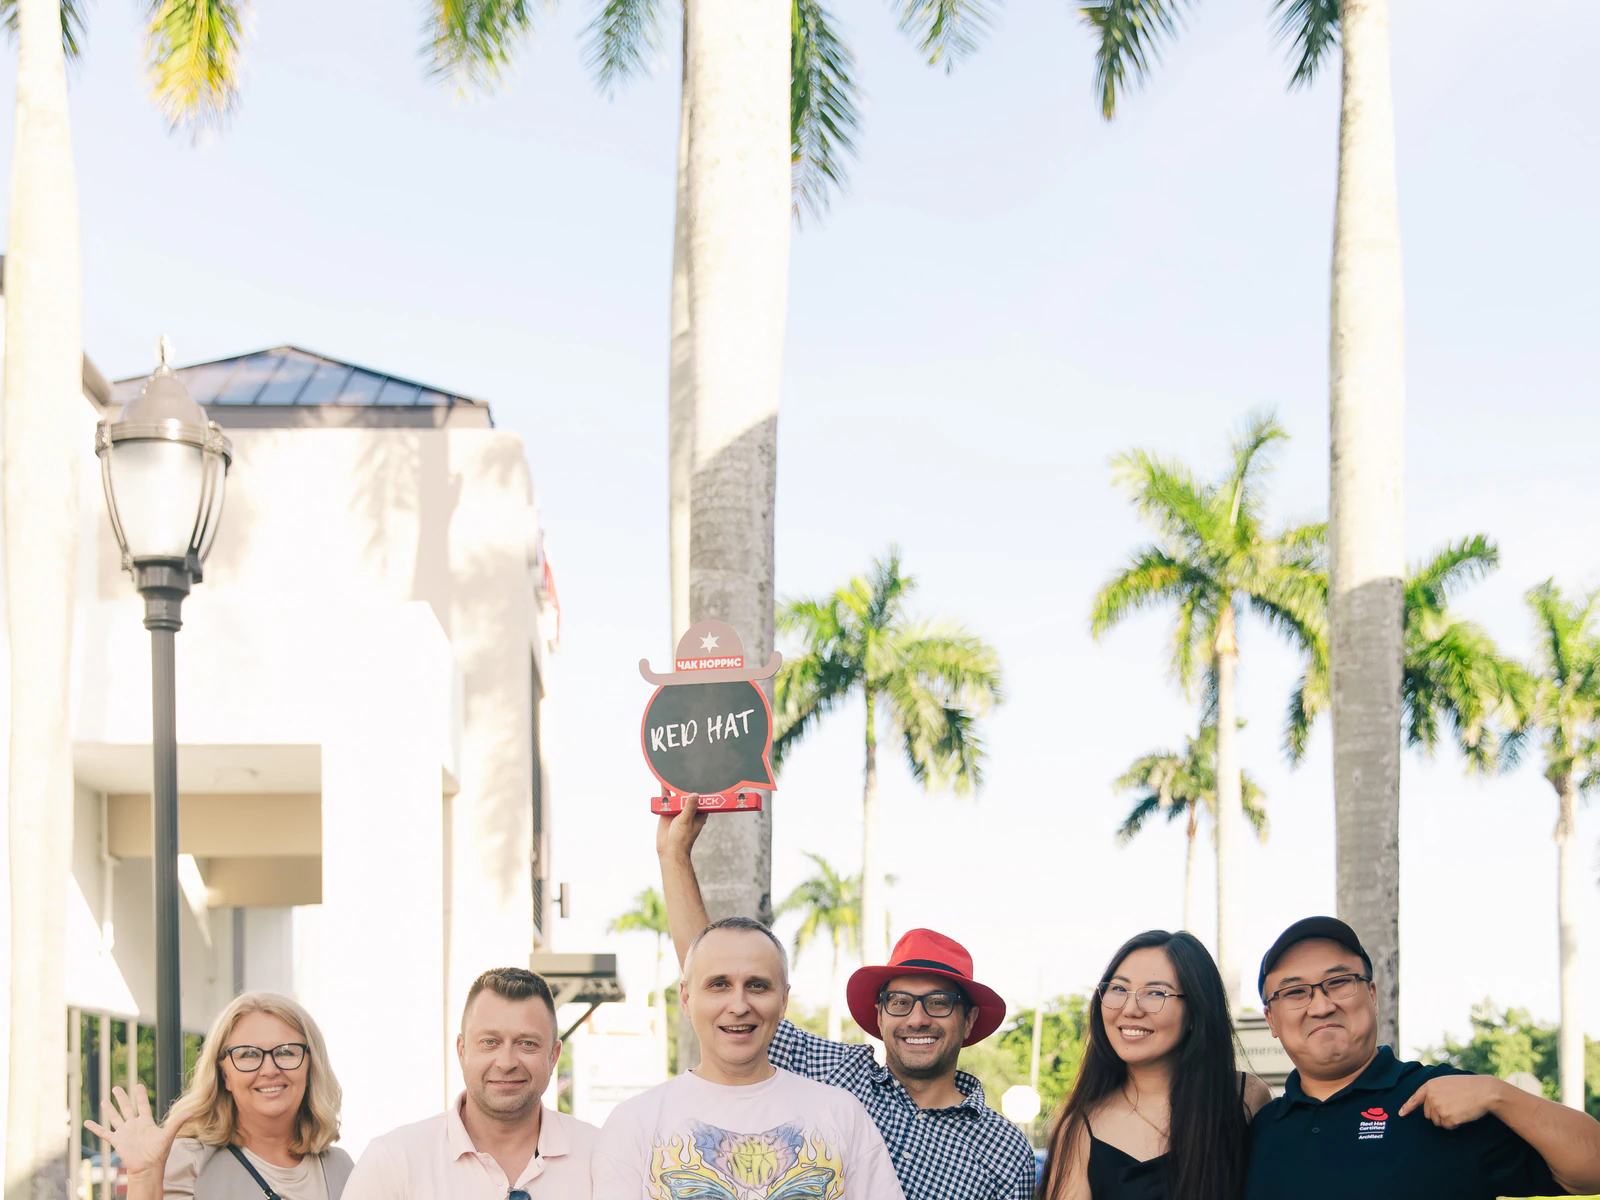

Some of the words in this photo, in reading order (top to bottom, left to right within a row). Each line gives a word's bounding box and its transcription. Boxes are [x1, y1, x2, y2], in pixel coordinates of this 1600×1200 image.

[677, 660, 698, 669] ЧАК
[699, 657, 742, 669] НОРРИС
[650, 719, 698, 752] RED
[707, 709, 755, 744] HAT
